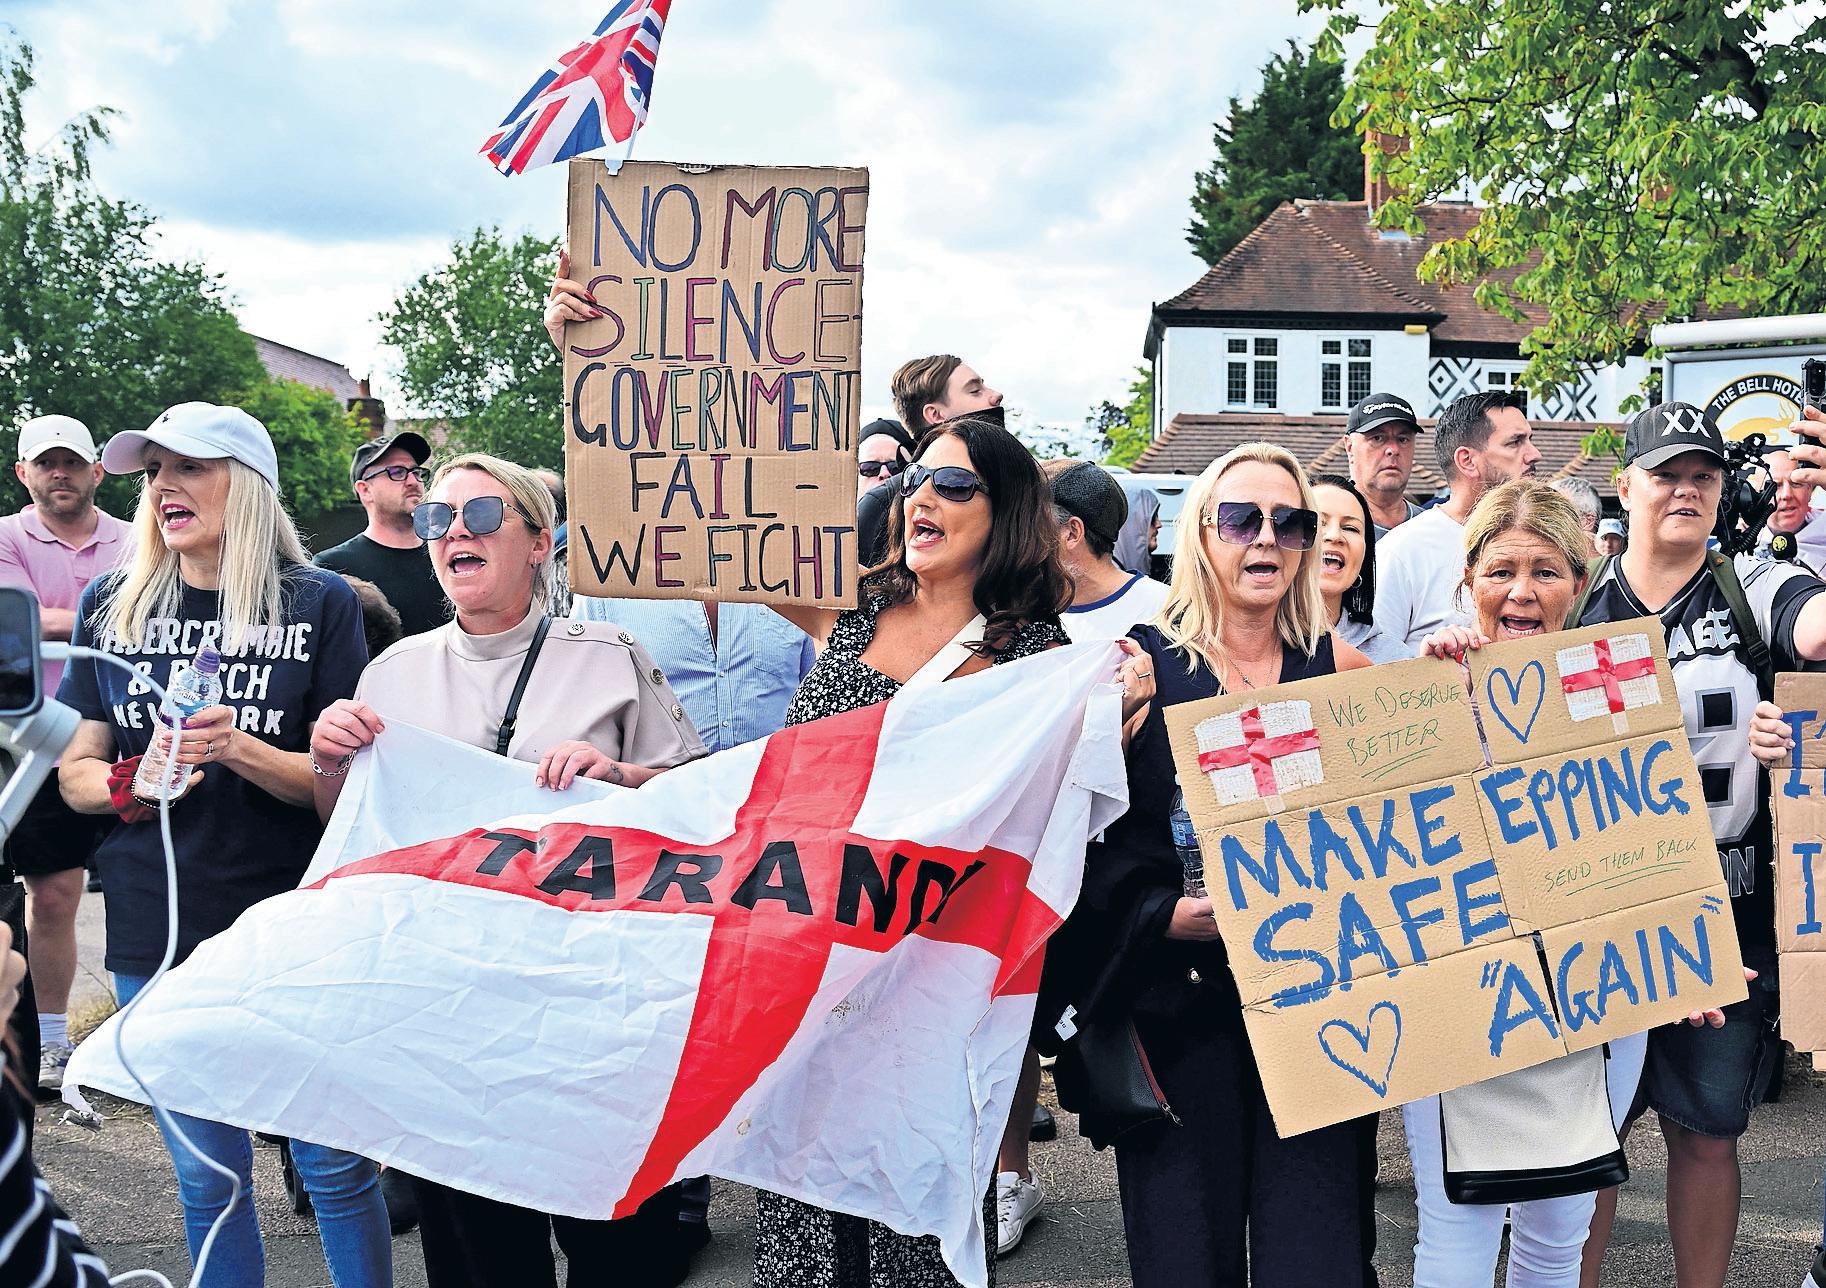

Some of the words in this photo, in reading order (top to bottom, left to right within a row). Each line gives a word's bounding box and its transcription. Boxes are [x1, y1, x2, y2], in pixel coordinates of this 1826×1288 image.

[593, 183, 701, 272] NO
[720, 186, 869, 273] MORE
[1711, 387, 1737, 410] THE
[1737, 378, 1770, 394] BELL
[1772, 379, 1804, 405] HOTE
[1660, 409, 1712, 438] XX
[629, 452, 778, 519] FAIL
[580, 523, 687, 588] WE
[707, 523, 855, 599] FIGHT
[1666, 607, 1741, 659] AGE
[168, 659, 272, 700] FCH
[1328, 695, 1367, 727] WE
[1375, 682, 1461, 718] DESERVE
[1347, 718, 1443, 766] BETTER
[1220, 784, 1463, 912] MAKE
[1480, 740, 1691, 850] EPPING
[1544, 861, 1592, 893] SEND
[1600, 846, 1645, 872] THEM
[1656, 836, 1698, 862] BACK
[1253, 859, 1510, 1009] SAFE
[1480, 895, 1724, 1057] "AGAIN"
